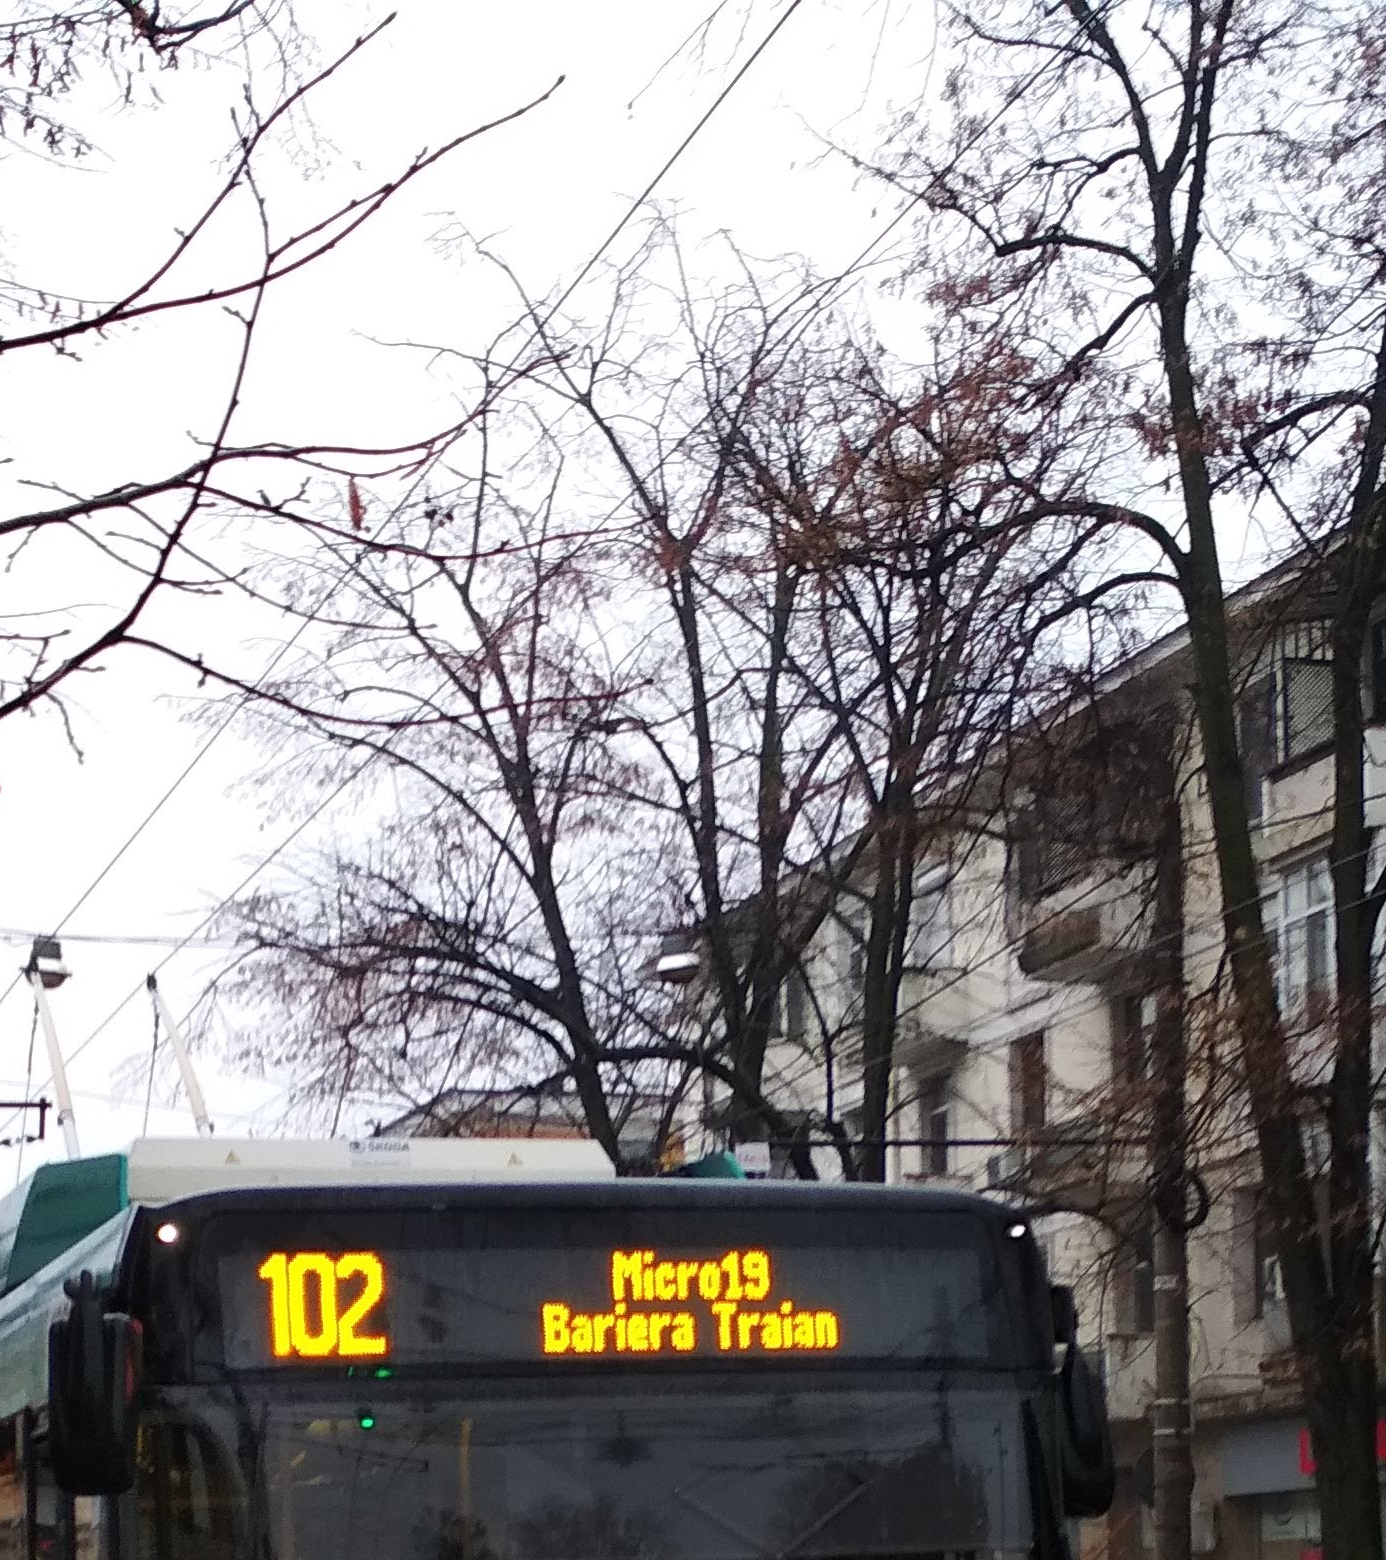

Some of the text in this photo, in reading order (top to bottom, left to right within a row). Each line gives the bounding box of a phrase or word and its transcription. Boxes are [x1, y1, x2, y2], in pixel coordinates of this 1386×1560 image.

[613, 1251, 770, 1300] Micro19
[258, 1252, 386, 1356] 102
[542, 1300, 839, 1353] Bariera Traian
